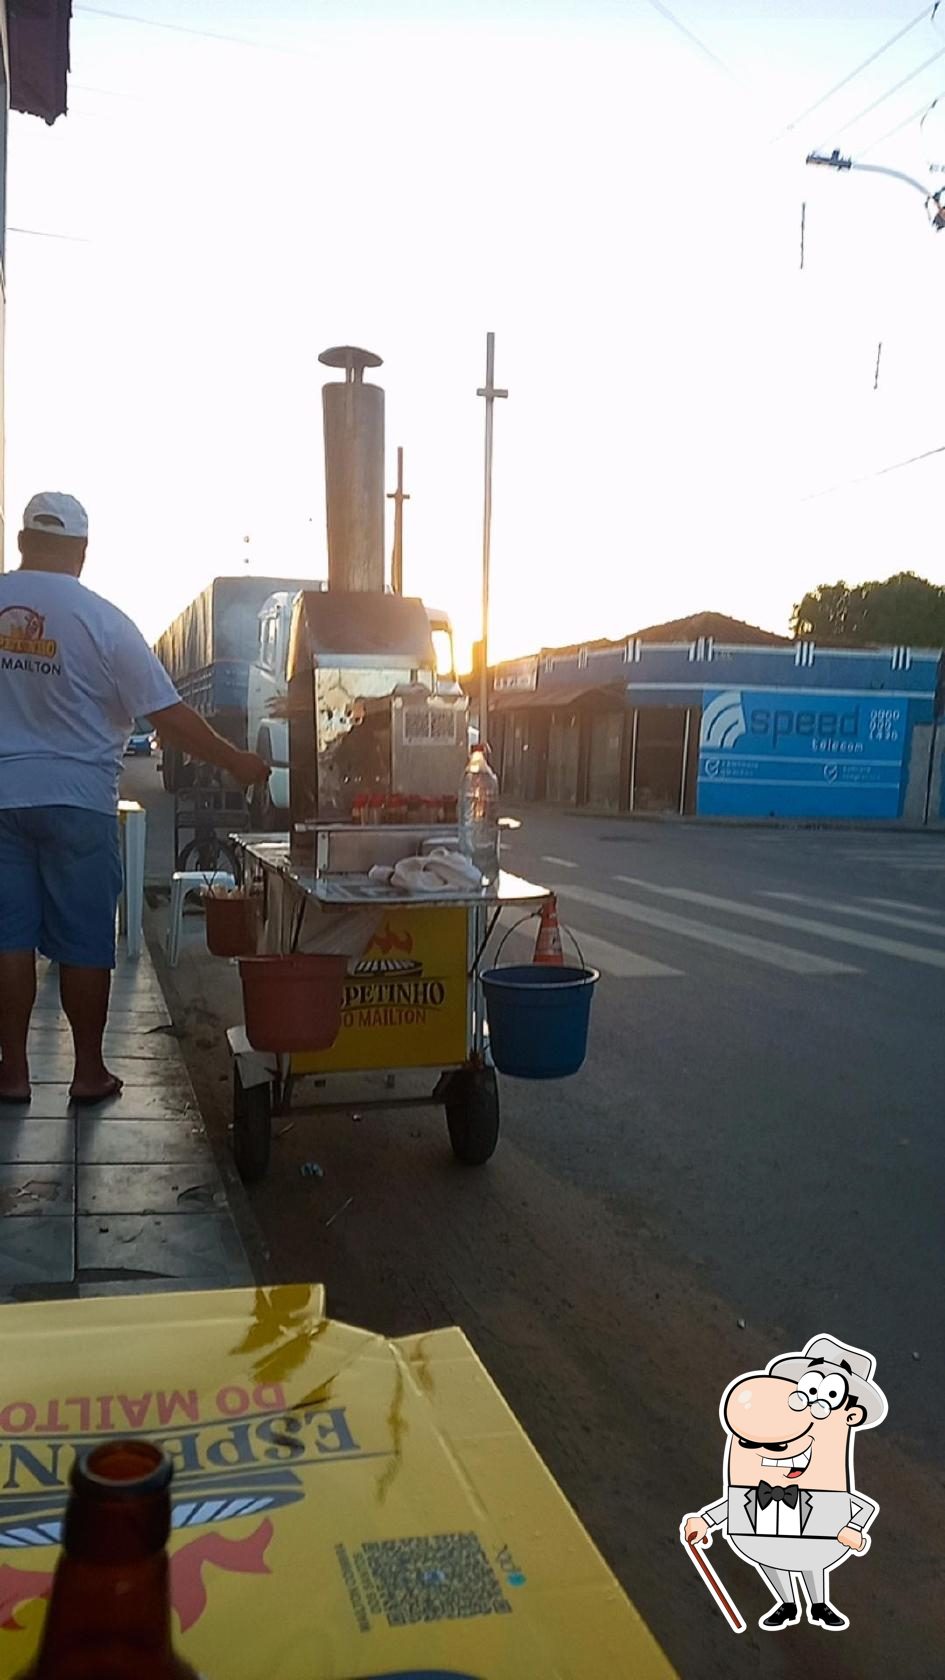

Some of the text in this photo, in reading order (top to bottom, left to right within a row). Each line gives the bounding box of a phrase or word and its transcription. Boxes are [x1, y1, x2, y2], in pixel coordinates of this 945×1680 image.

[1, 657, 61, 676] MAILTON
[751, 704, 860, 748] speed
[811, 738, 864, 752] telecom
[341, 982, 446, 1006] PETINHO
[359, 1007, 427, 1028] MAILTON
[215, 1382, 287, 1416] DO
